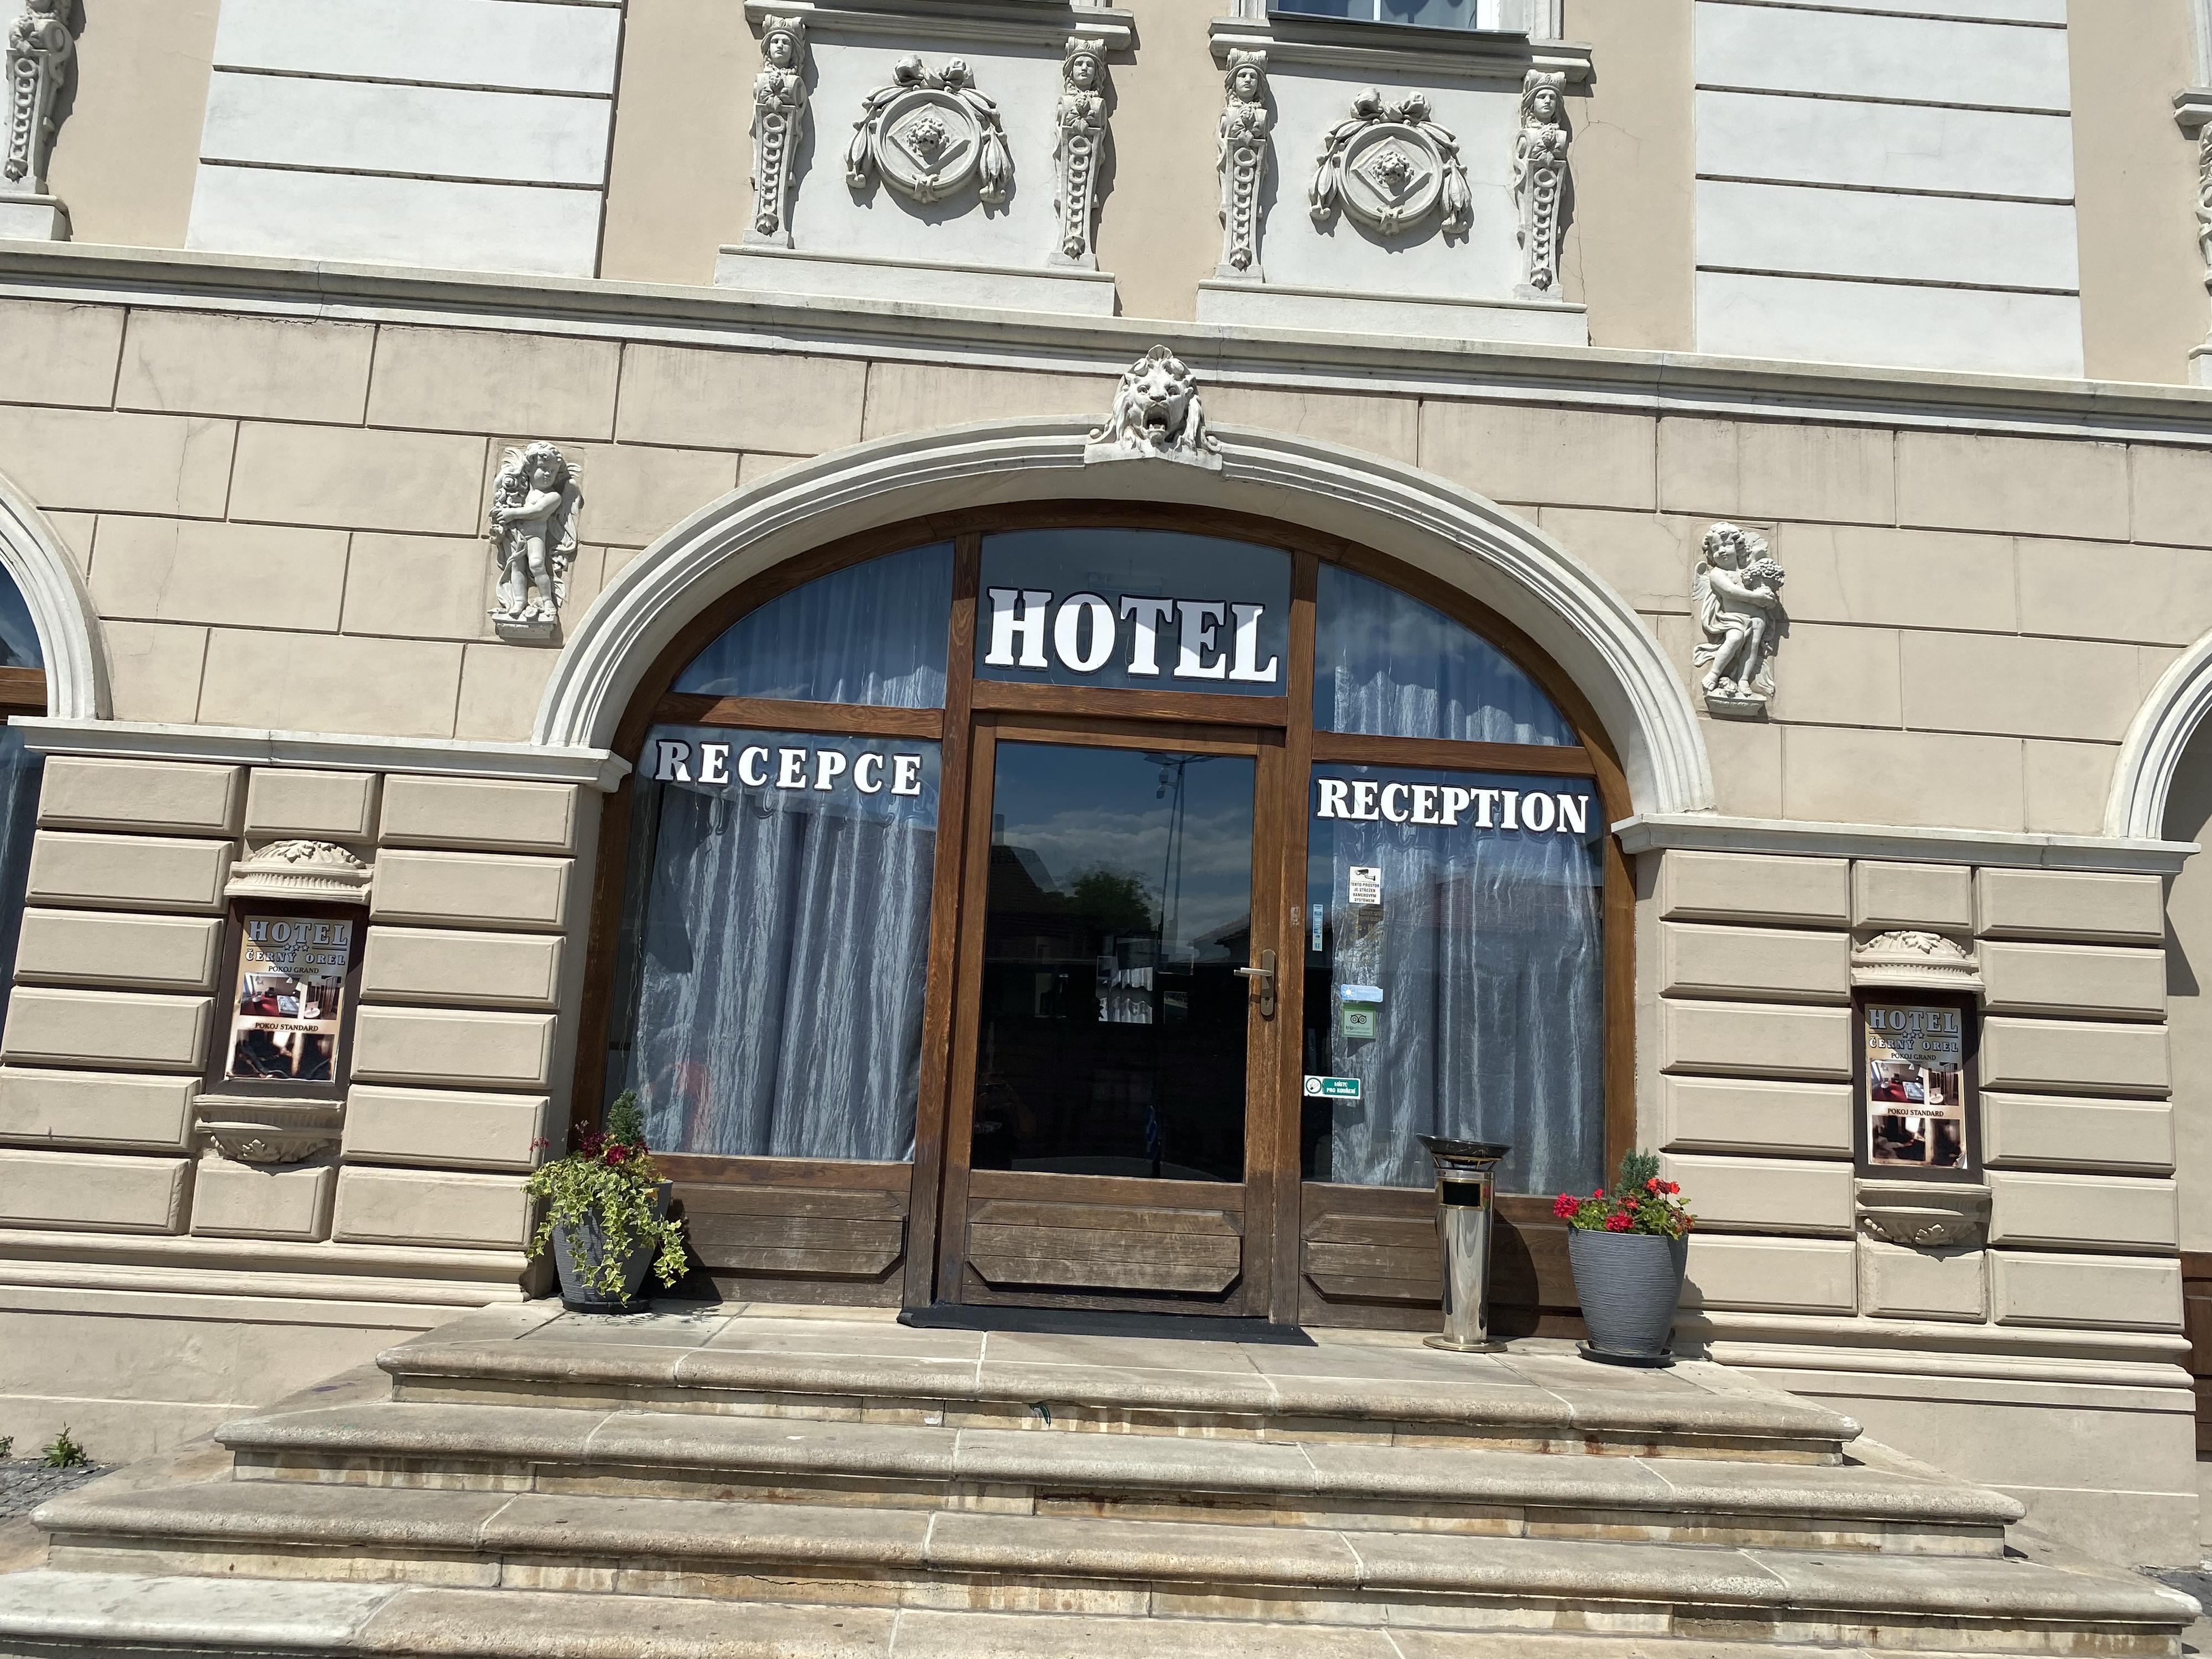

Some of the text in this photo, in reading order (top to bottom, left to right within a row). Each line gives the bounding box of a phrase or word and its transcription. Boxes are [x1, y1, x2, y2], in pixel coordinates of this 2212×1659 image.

[983, 586, 1278, 684] HOTEL
[654, 739, 923, 796] RECEPCE
[1316, 778, 1589, 834] RECEPTION
[248, 920, 347, 945] HOTEL
[246, 948, 346, 966] ČERNÝ OREL
[1869, 1009, 1958, 1033] HOTEL
[1869, 1036, 1958, 1052] ČERNÝ OREL
